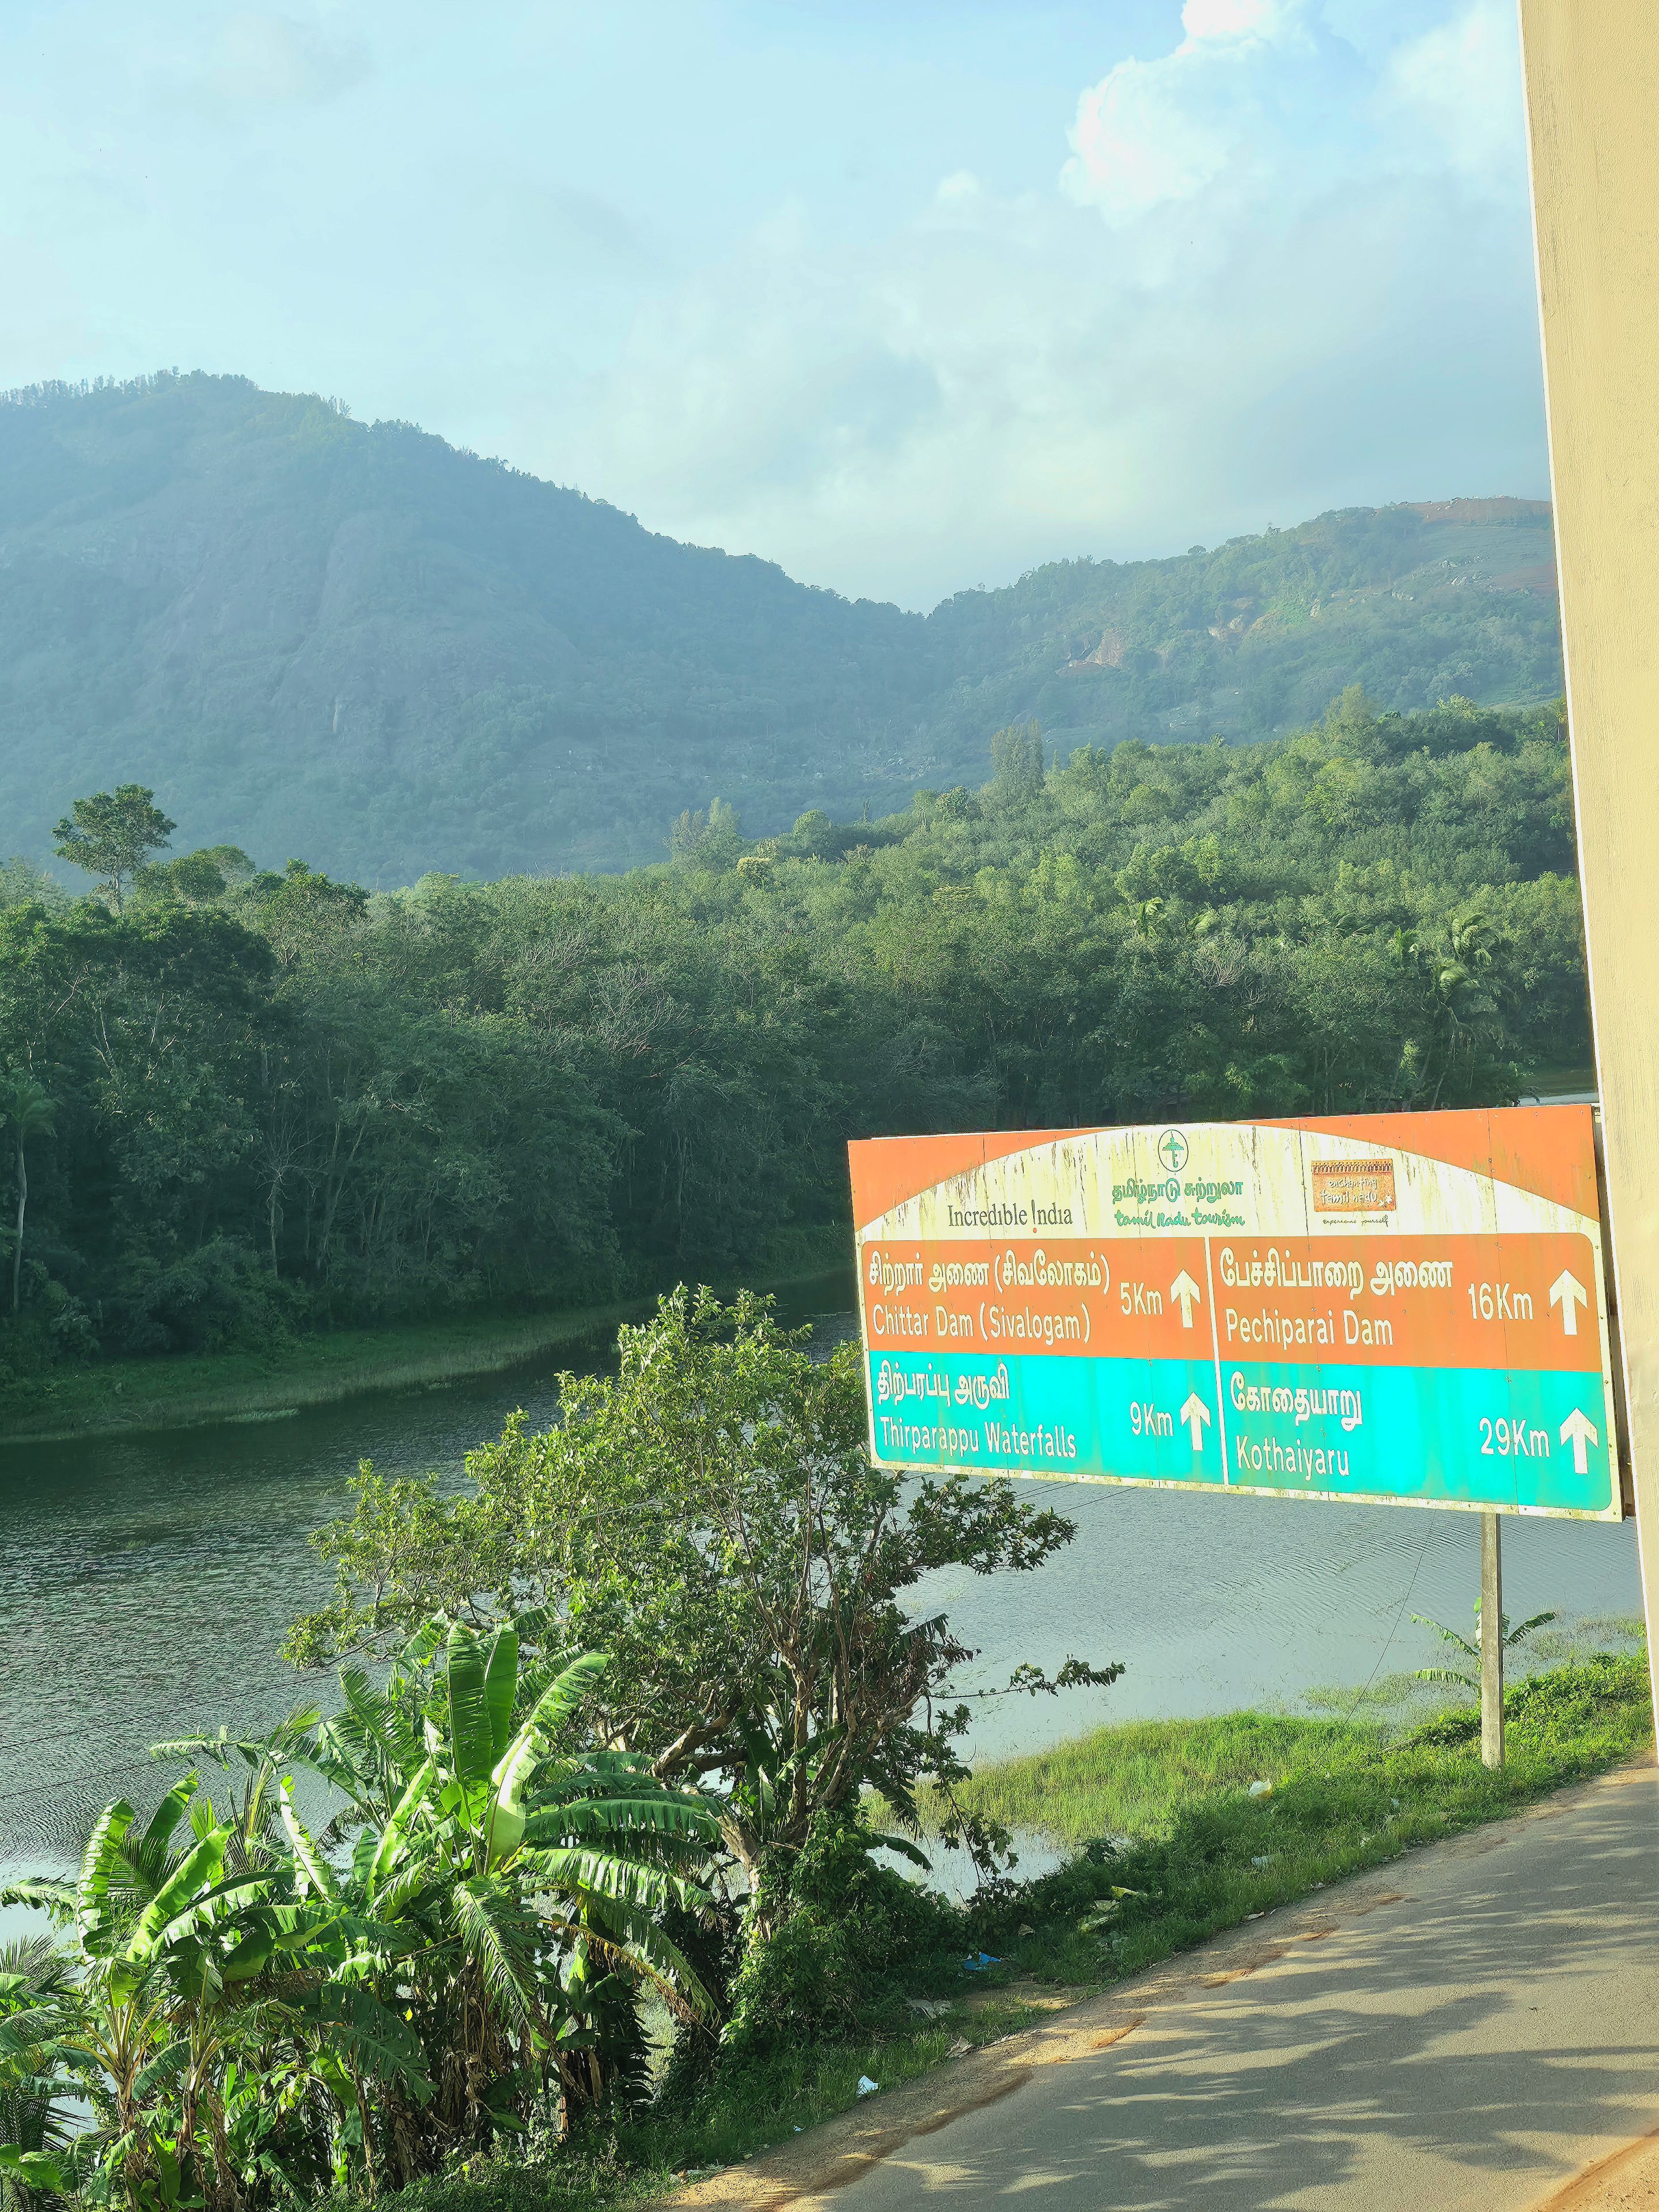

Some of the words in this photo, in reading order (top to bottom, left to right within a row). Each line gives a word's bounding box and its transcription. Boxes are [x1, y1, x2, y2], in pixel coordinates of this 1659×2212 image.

[1112, 1177, 1180, 1205] தமிழ்நாடு
[1184, 1176, 1243, 1204] சுற்றுலா
[1328, 1177, 1377, 1189] enchanting
[948, 1203, 1028, 1226] Incredible
[869, 1249, 924, 1296] சிற்றார்
[928, 1262, 990, 1293] அணை
[1219, 1247, 1364, 1300] பேச்சிப்பாறை
[1370, 1260, 1453, 1296] அணை
[1120, 1282, 1162, 1315] 5Km
[1468, 1282, 1533, 1320] 16Km
[873, 1304, 929, 1336] Chittar
[935, 1305, 974, 1337] Dam
[979, 1301, 1090, 1346] (Sivalogam)
[1225, 1308, 1335, 1350] Pechiparai
[1343, 1309, 1393, 1345] Dam
[877, 1359, 951, 1407] திற்பரப்பு
[954, 1362, 1010, 1410] அருவி
[1230, 1370, 1363, 1431] கோதையாறு
[880, 1416, 979, 1457] Thirparappu
[984, 1421, 1077, 1459] Waterfalls
[1130, 1401, 1173, 1437] 9Km
[1479, 1417, 1550, 1458] 29Km
[1236, 1435, 1350, 1481] Kothaiyaru
